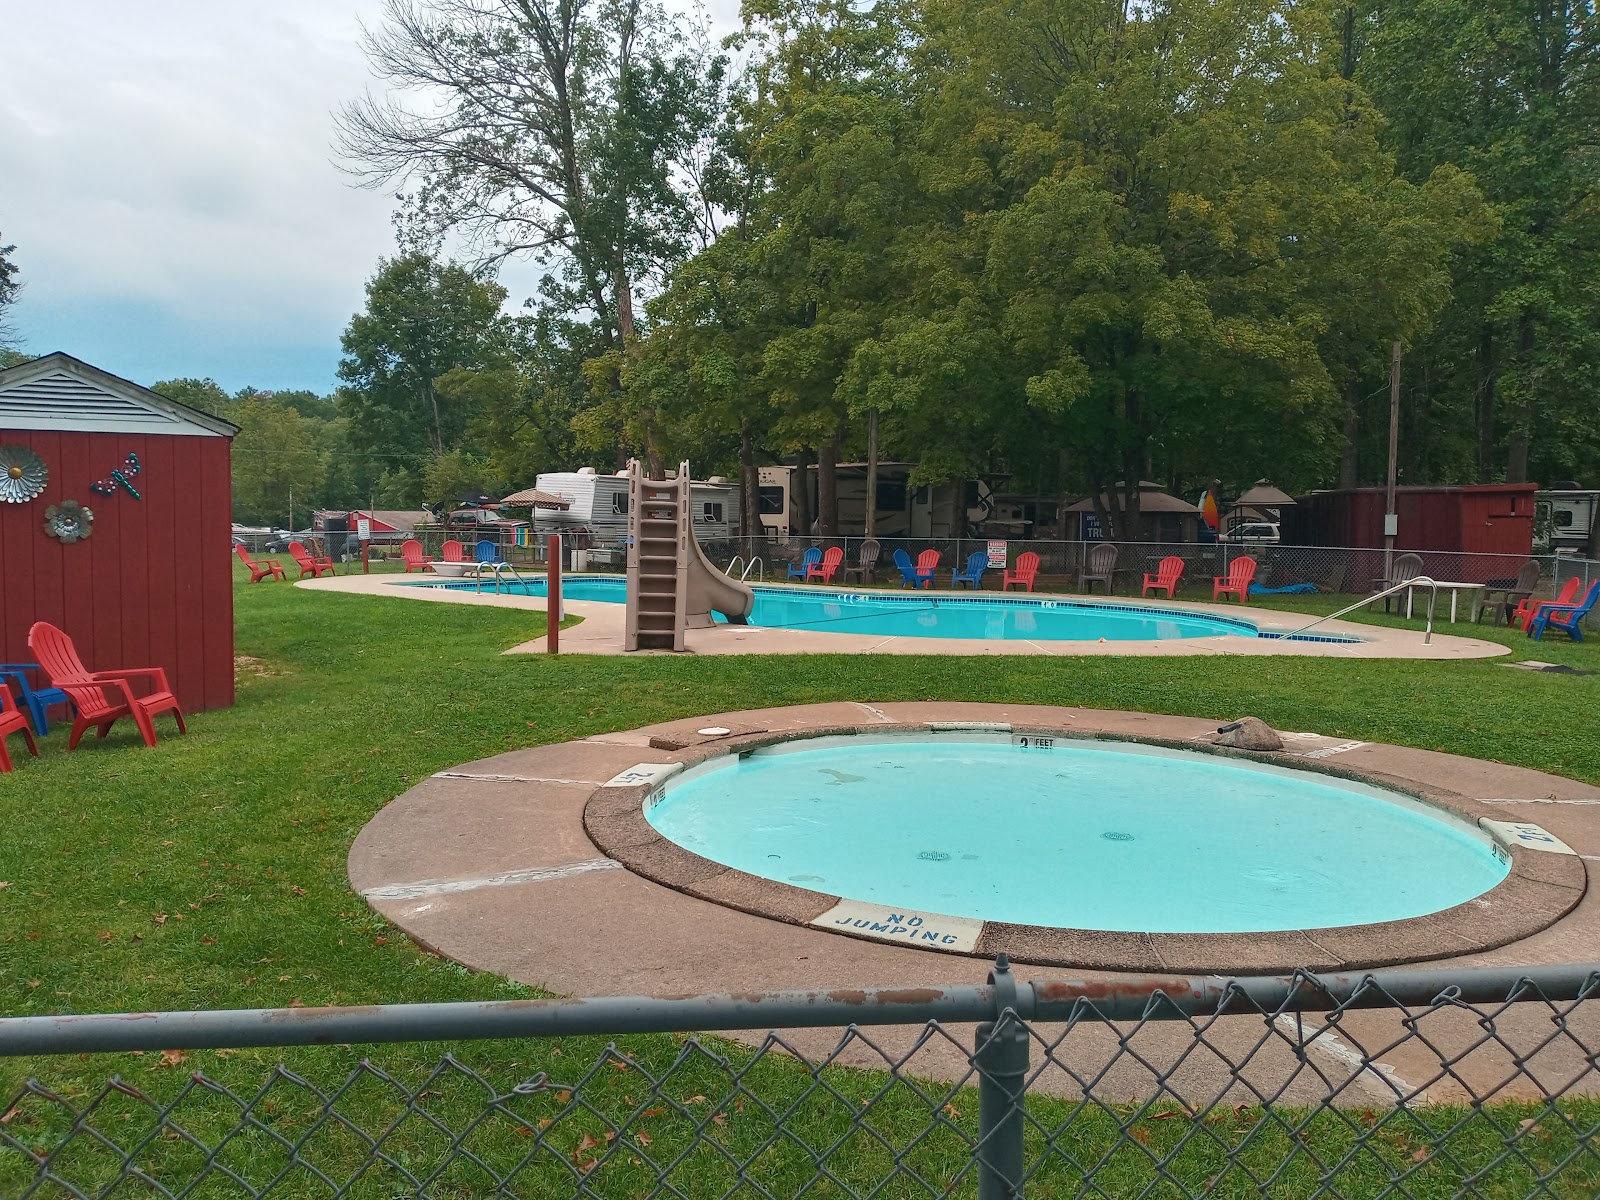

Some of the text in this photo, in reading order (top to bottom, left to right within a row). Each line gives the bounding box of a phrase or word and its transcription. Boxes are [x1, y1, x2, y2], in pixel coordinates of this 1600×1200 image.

[1035, 738, 1054, 749] FEET
[886, 913, 924, 927] NO
[835, 917, 958, 945] JUMPING
